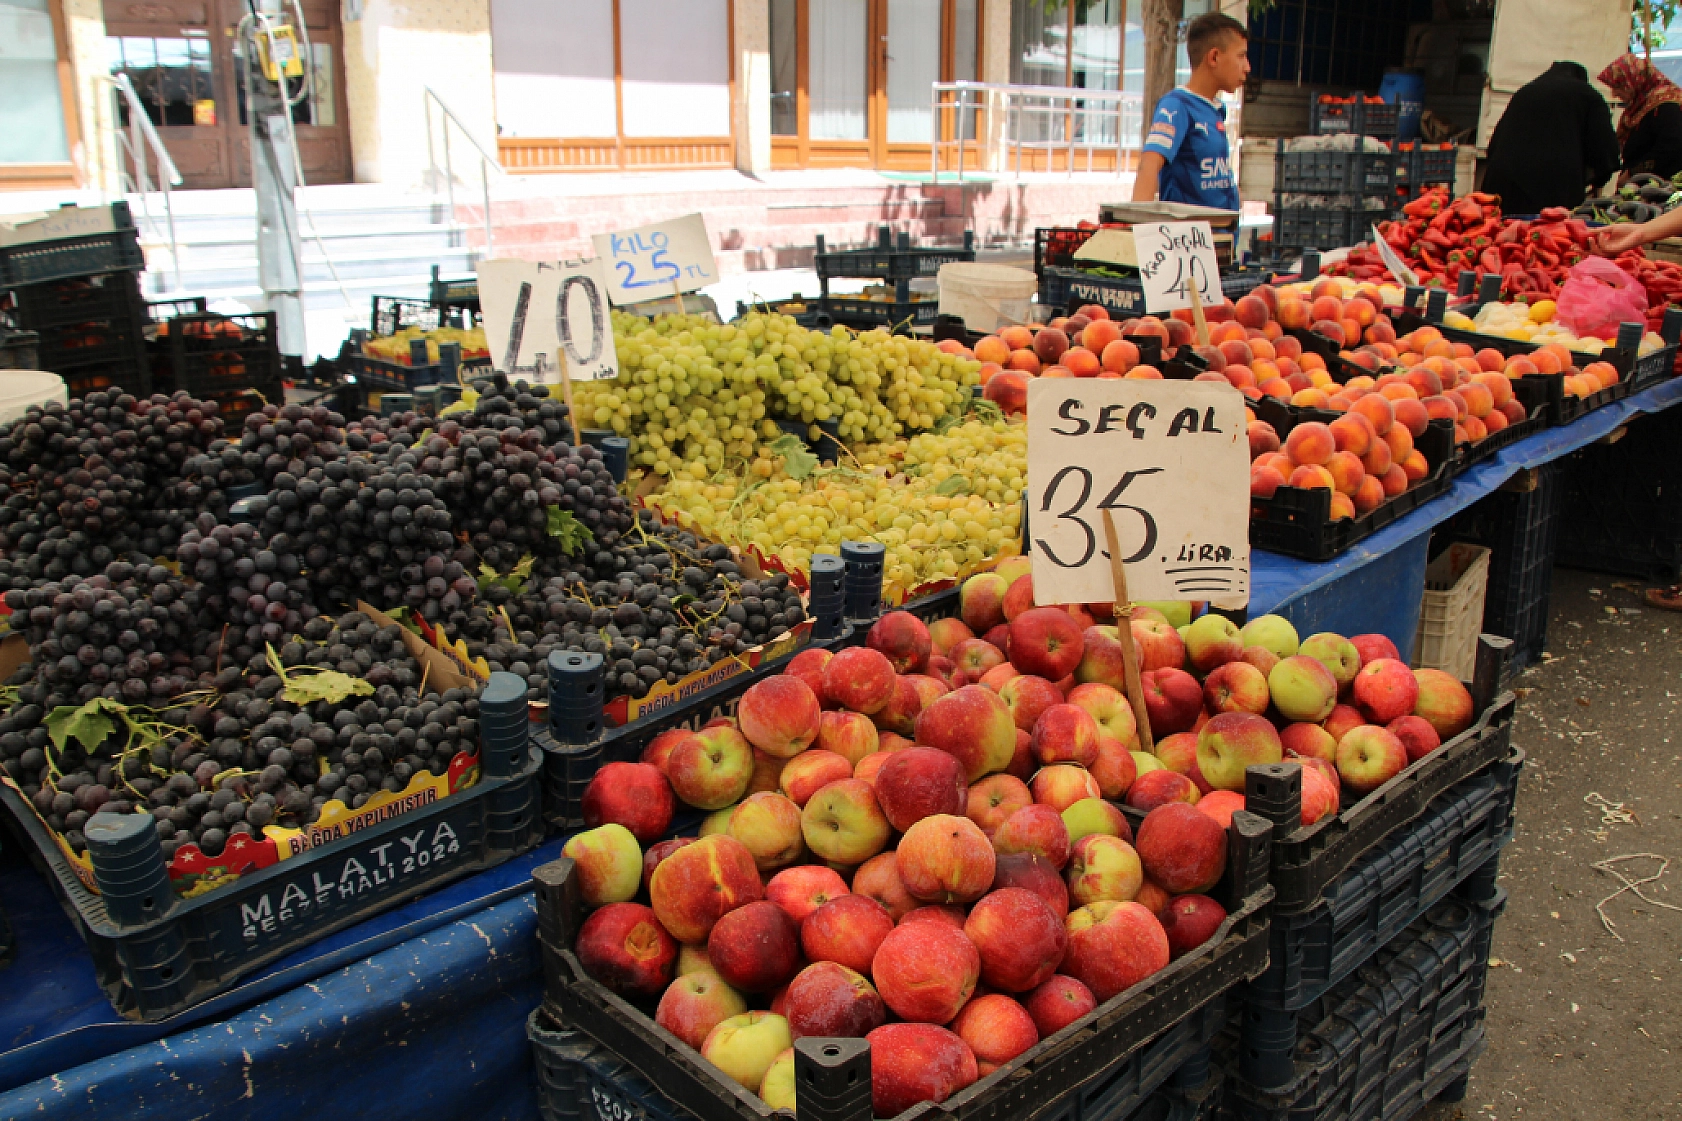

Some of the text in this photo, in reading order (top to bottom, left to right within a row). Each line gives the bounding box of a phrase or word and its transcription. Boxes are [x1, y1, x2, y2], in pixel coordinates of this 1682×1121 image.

[610, 231, 669, 258] KILO
[615, 249, 710, 289] 25 TL
[1162, 255, 1209, 300] 40
[502, 275, 604, 382] 40
[1050, 398, 1223, 440] SEÇ AL
[1035, 465, 1165, 568] 35
[242, 821, 457, 927] MALATYA
[402, 838, 460, 873] 2024
